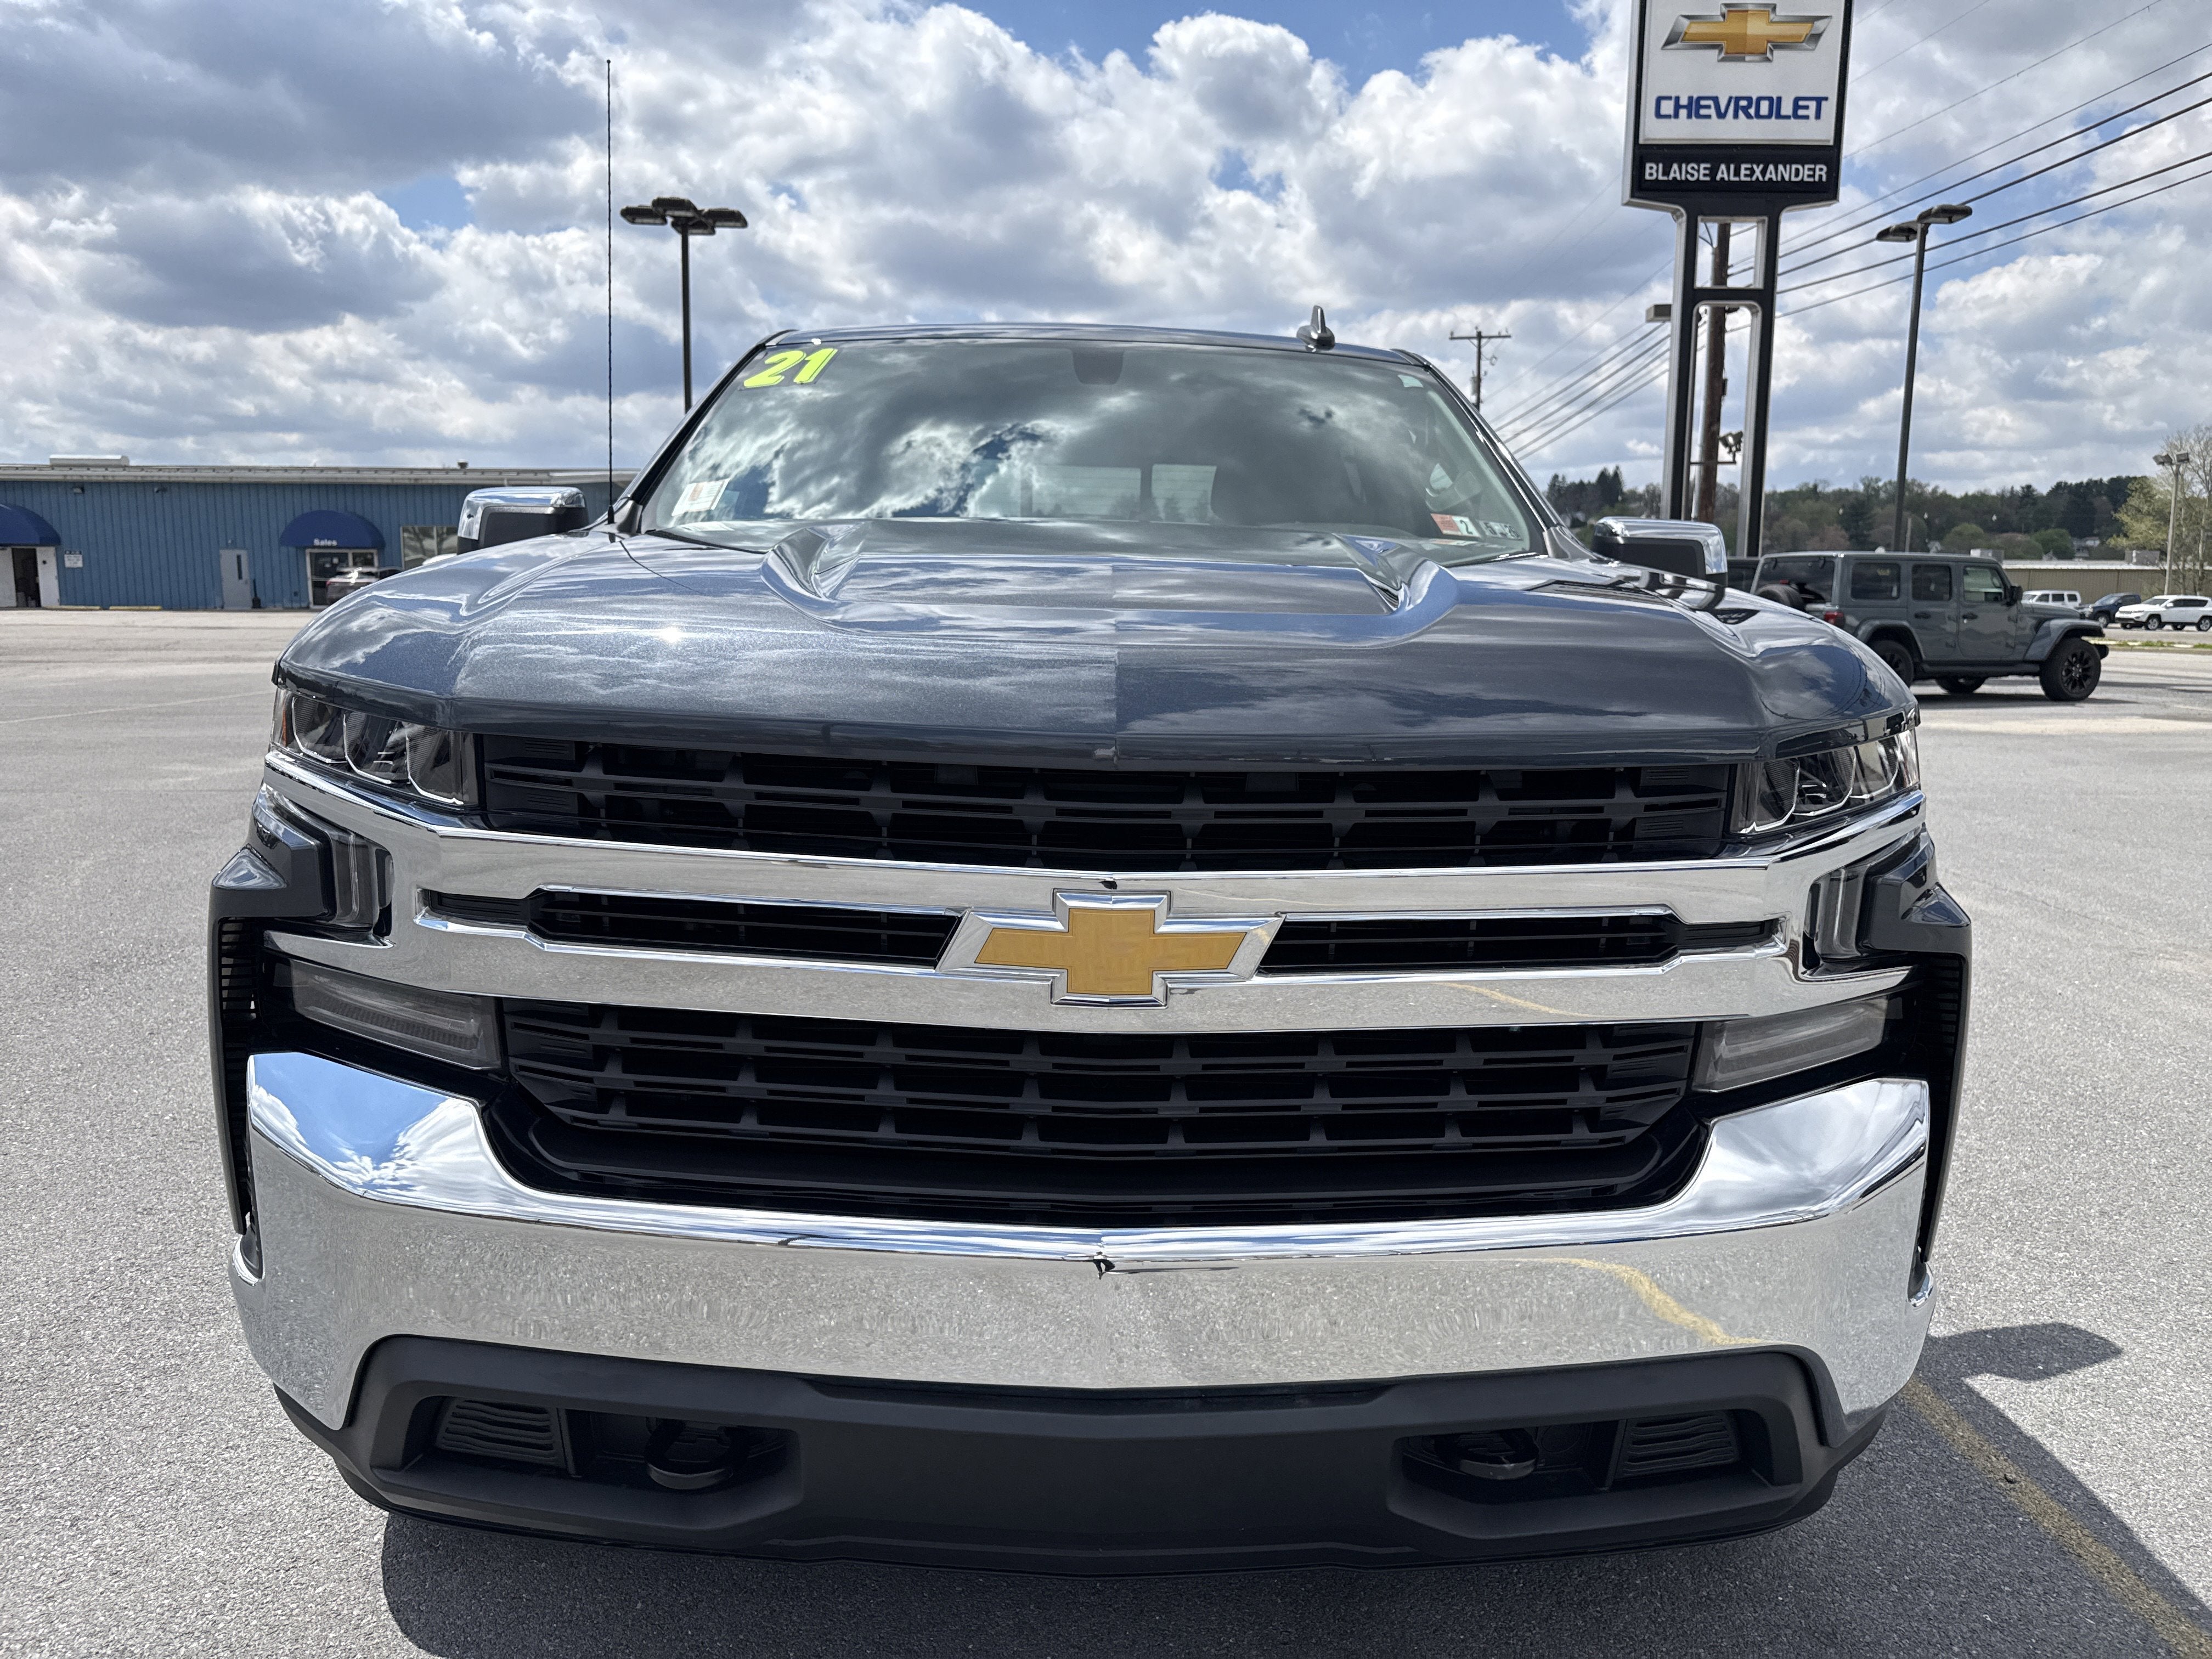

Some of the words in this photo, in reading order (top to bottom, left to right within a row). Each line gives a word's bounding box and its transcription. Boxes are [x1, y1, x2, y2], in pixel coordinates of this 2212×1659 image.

[1655, 95, 1829, 120] CHEVROLET
[1645, 162, 1711, 180] BLAISE
[1716, 163, 1827, 182] ALEXANDER
[744, 348, 838, 388] 21
[313, 538, 338, 546] Sales
